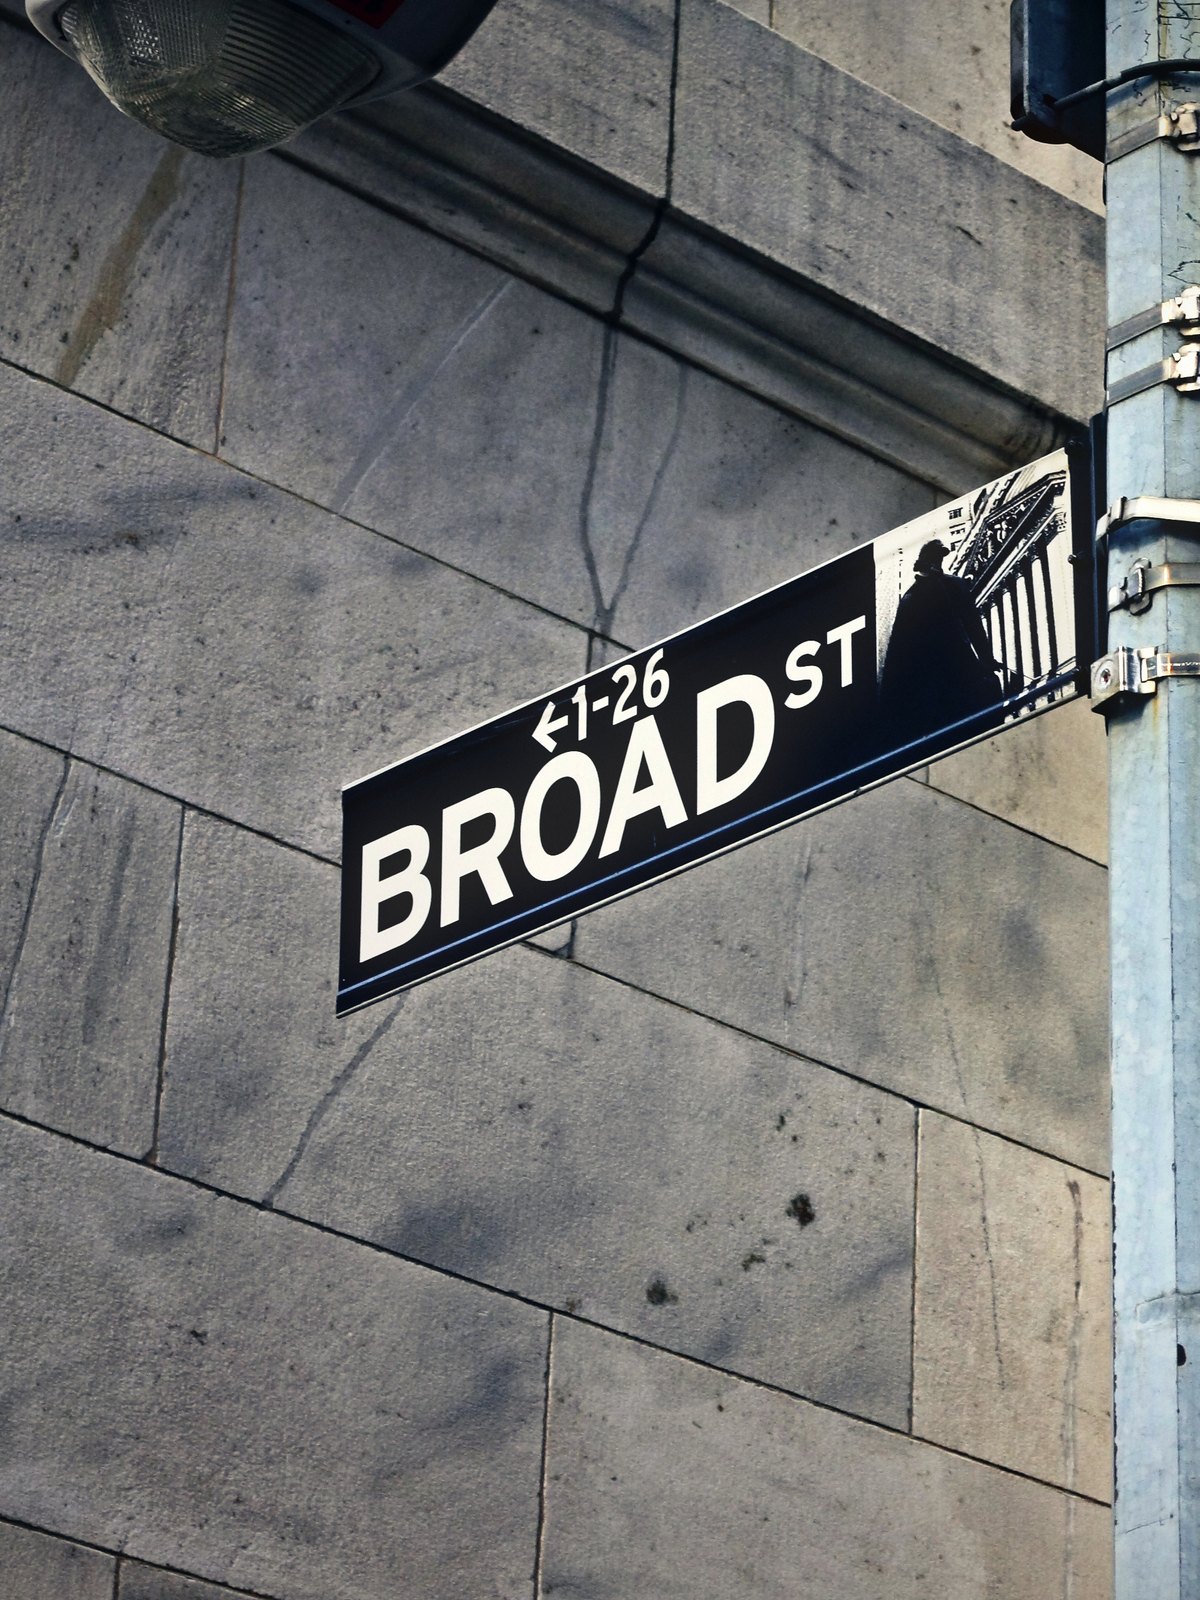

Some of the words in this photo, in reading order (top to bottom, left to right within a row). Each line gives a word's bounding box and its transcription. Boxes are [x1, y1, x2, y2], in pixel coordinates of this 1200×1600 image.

[358, 674, 776, 964] BROAD
[784, 614, 867, 711] ST
[571, 647, 671, 742] 1-26
